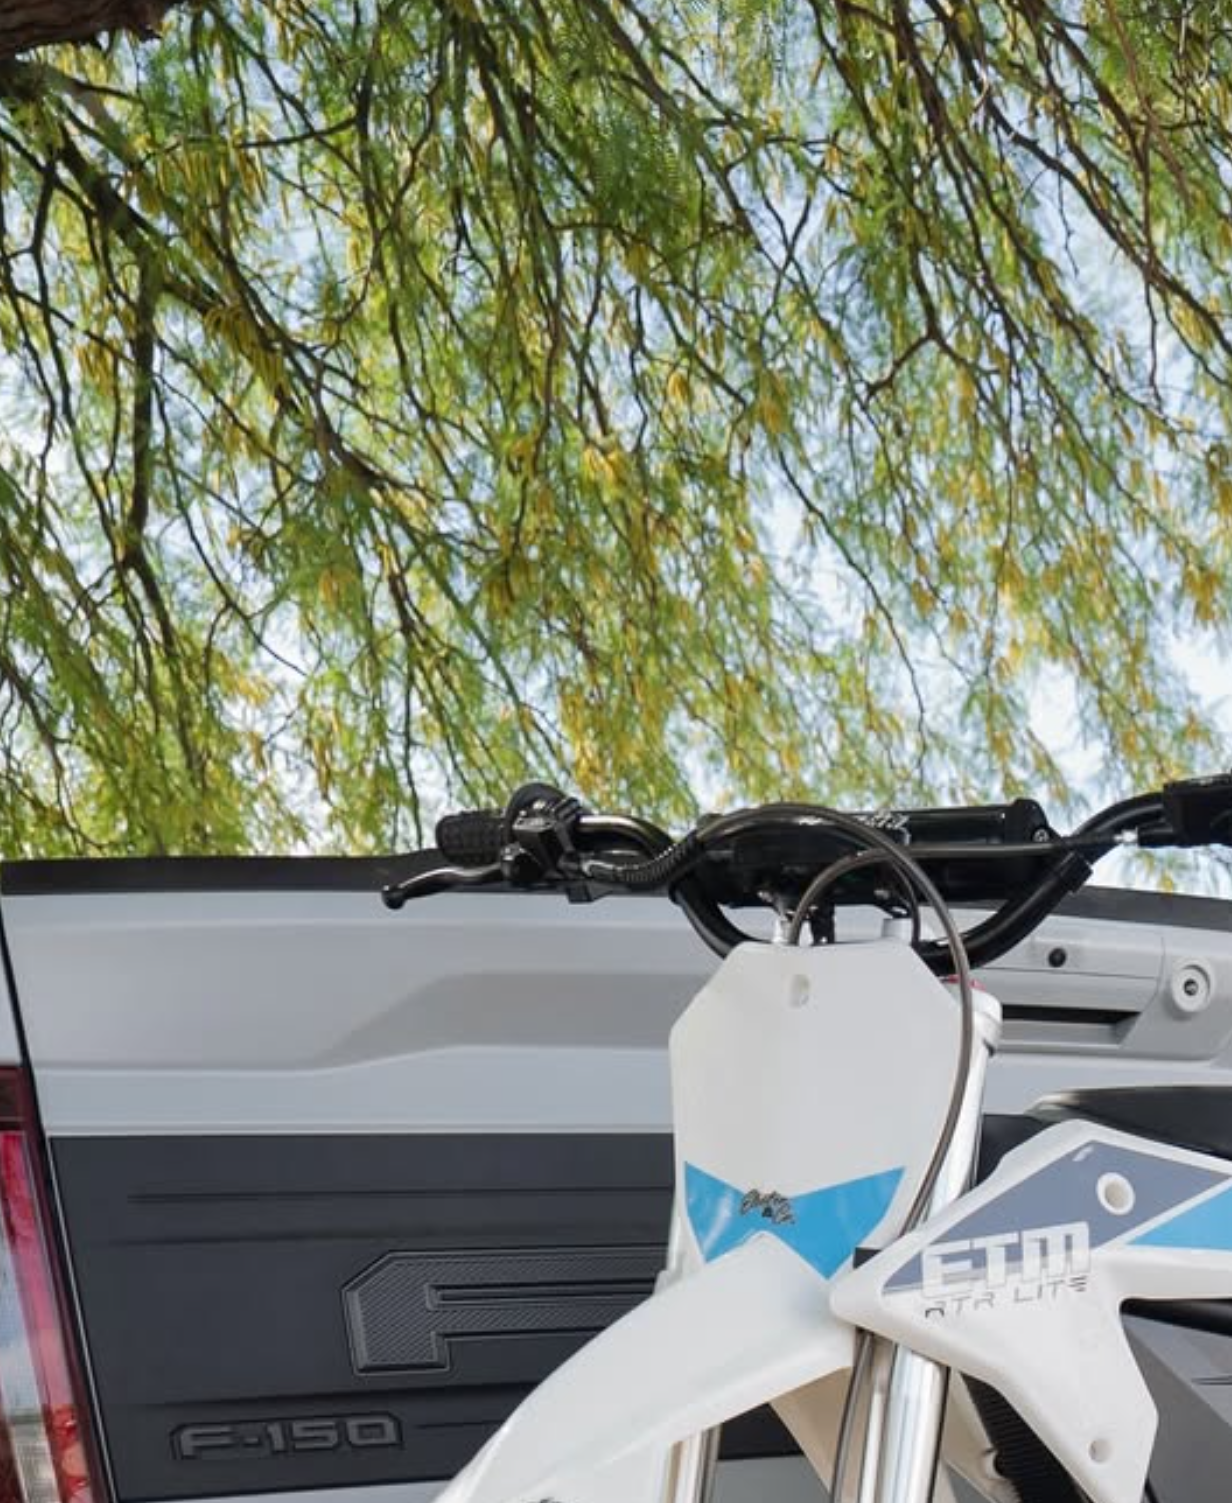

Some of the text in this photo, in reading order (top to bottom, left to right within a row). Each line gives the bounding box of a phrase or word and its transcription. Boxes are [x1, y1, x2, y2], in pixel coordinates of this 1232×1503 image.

[921, 1221, 1091, 1298] ETM
[1013, 1273, 1088, 1303] LITE
[174, 1412, 403, 1460] F-150
